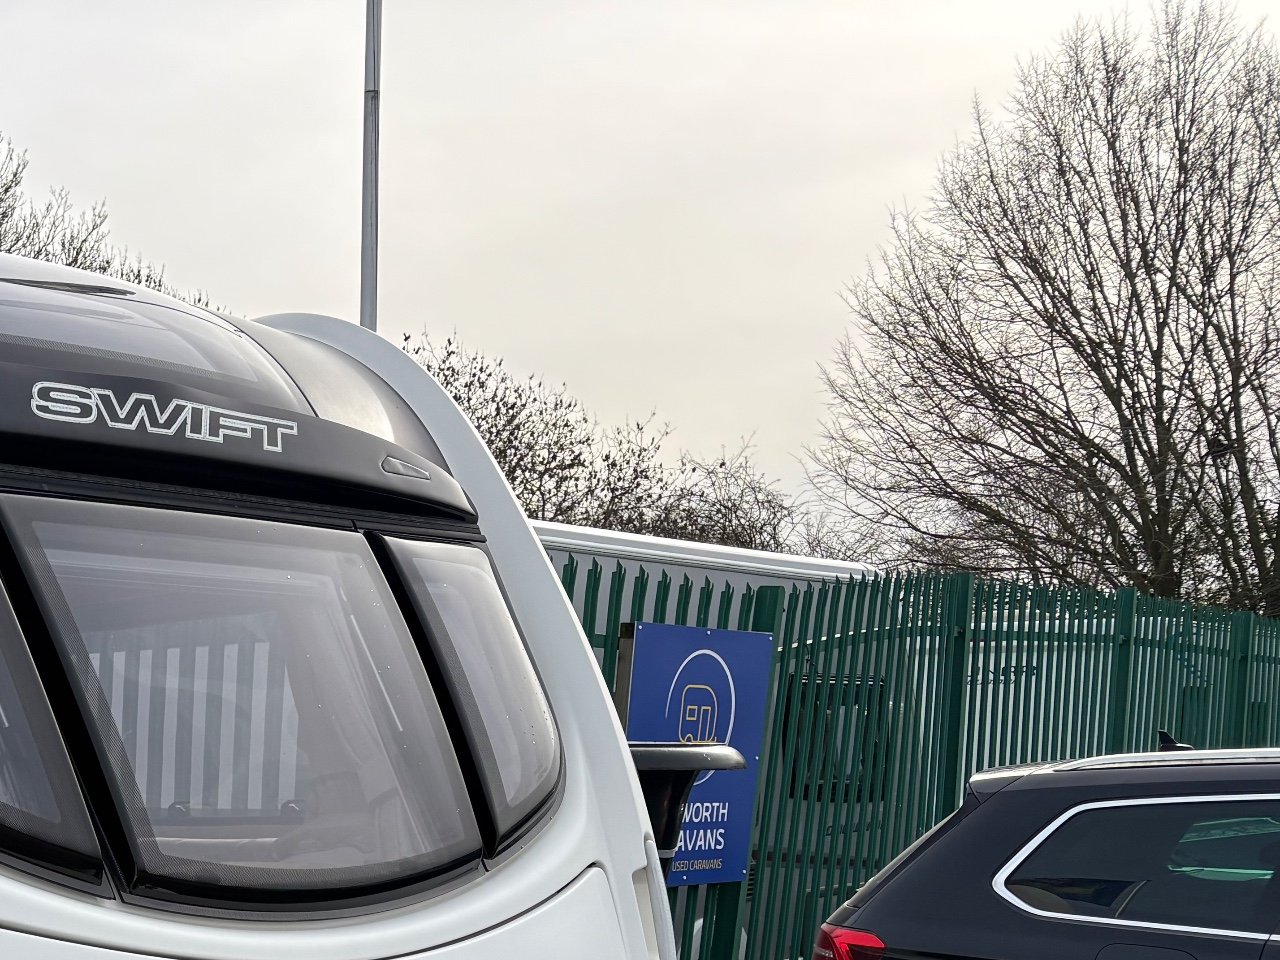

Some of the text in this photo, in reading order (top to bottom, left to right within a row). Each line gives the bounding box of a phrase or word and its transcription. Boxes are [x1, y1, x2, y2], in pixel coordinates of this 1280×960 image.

[31, 381, 298, 452] SWIFT
[672, 858, 723, 871] USED CARAVANS
